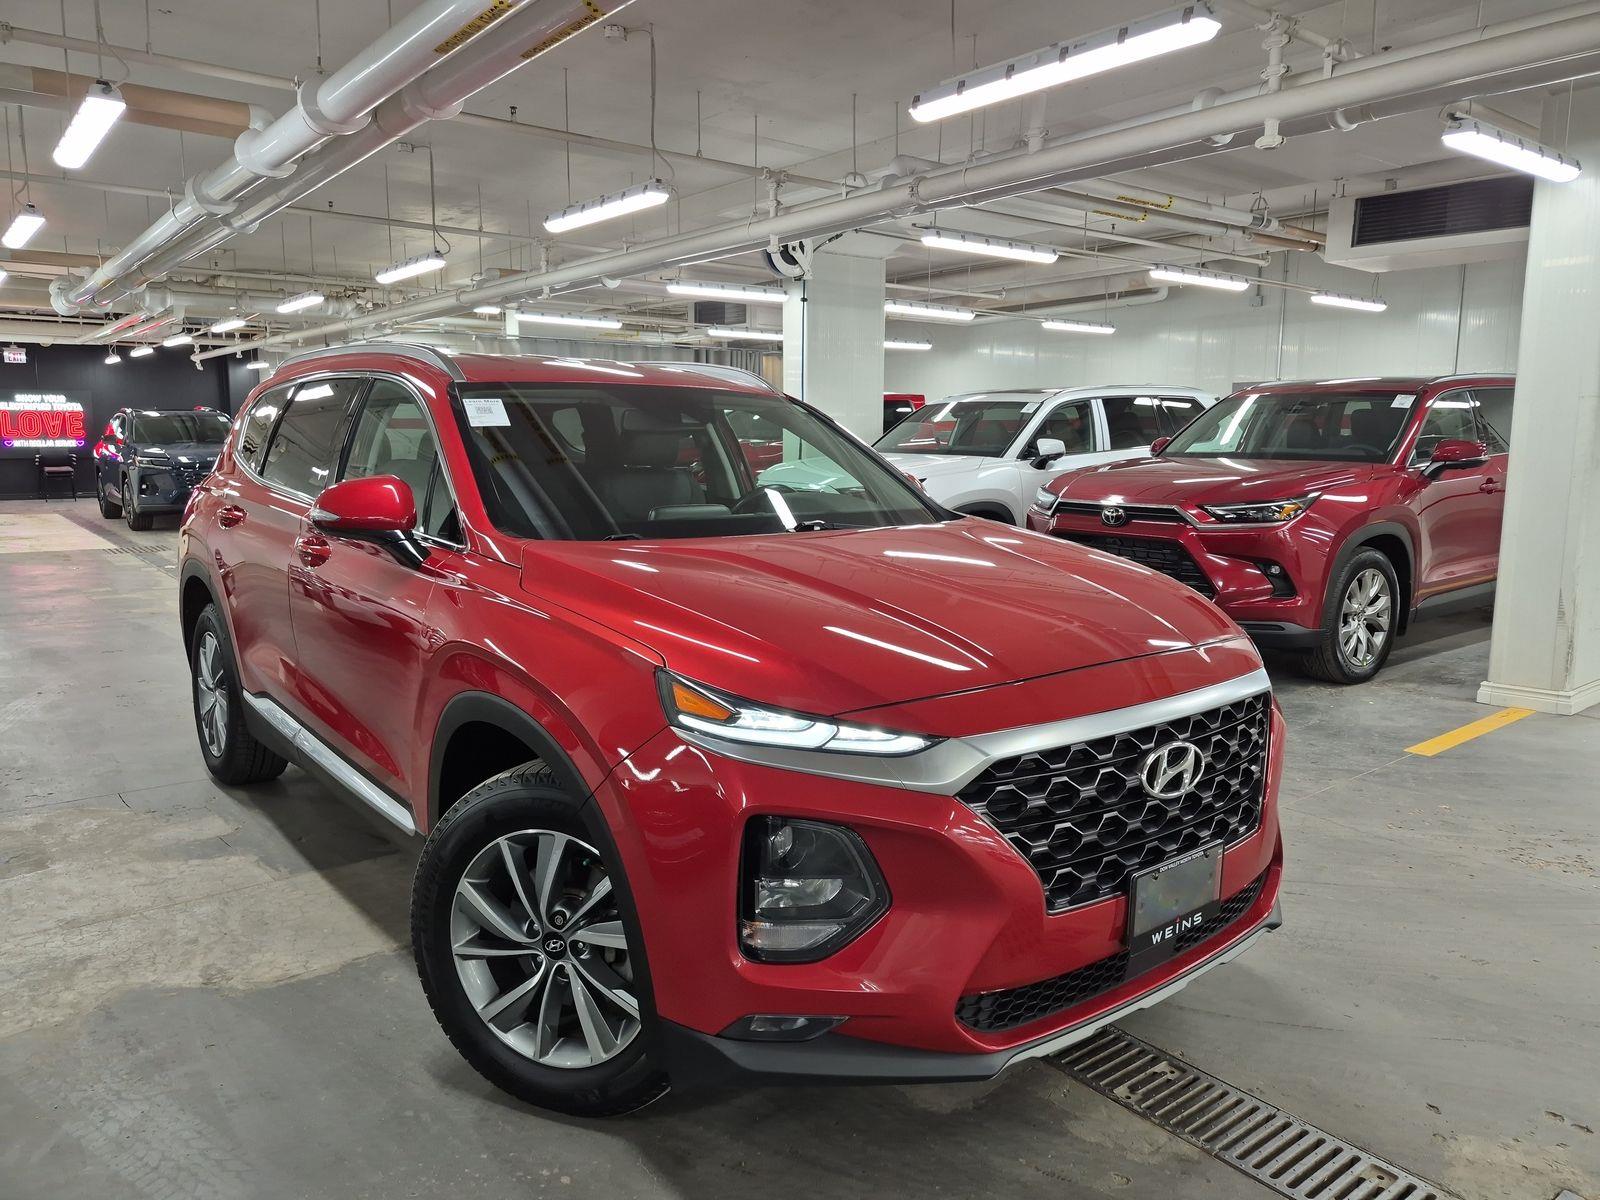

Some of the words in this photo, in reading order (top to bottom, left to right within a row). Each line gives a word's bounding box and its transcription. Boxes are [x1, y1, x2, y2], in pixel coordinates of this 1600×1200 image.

[14, 394, 42, 402] SHOW
[43, 394, 67, 402] YOUR
[52, 402, 83, 411] TOYOTA
[1, 410, 86, 438] LOVE
[13, 439, 29, 447] WITH
[29, 439, 54, 447] REGULAR
[55, 439, 77, 447] SERVICE
